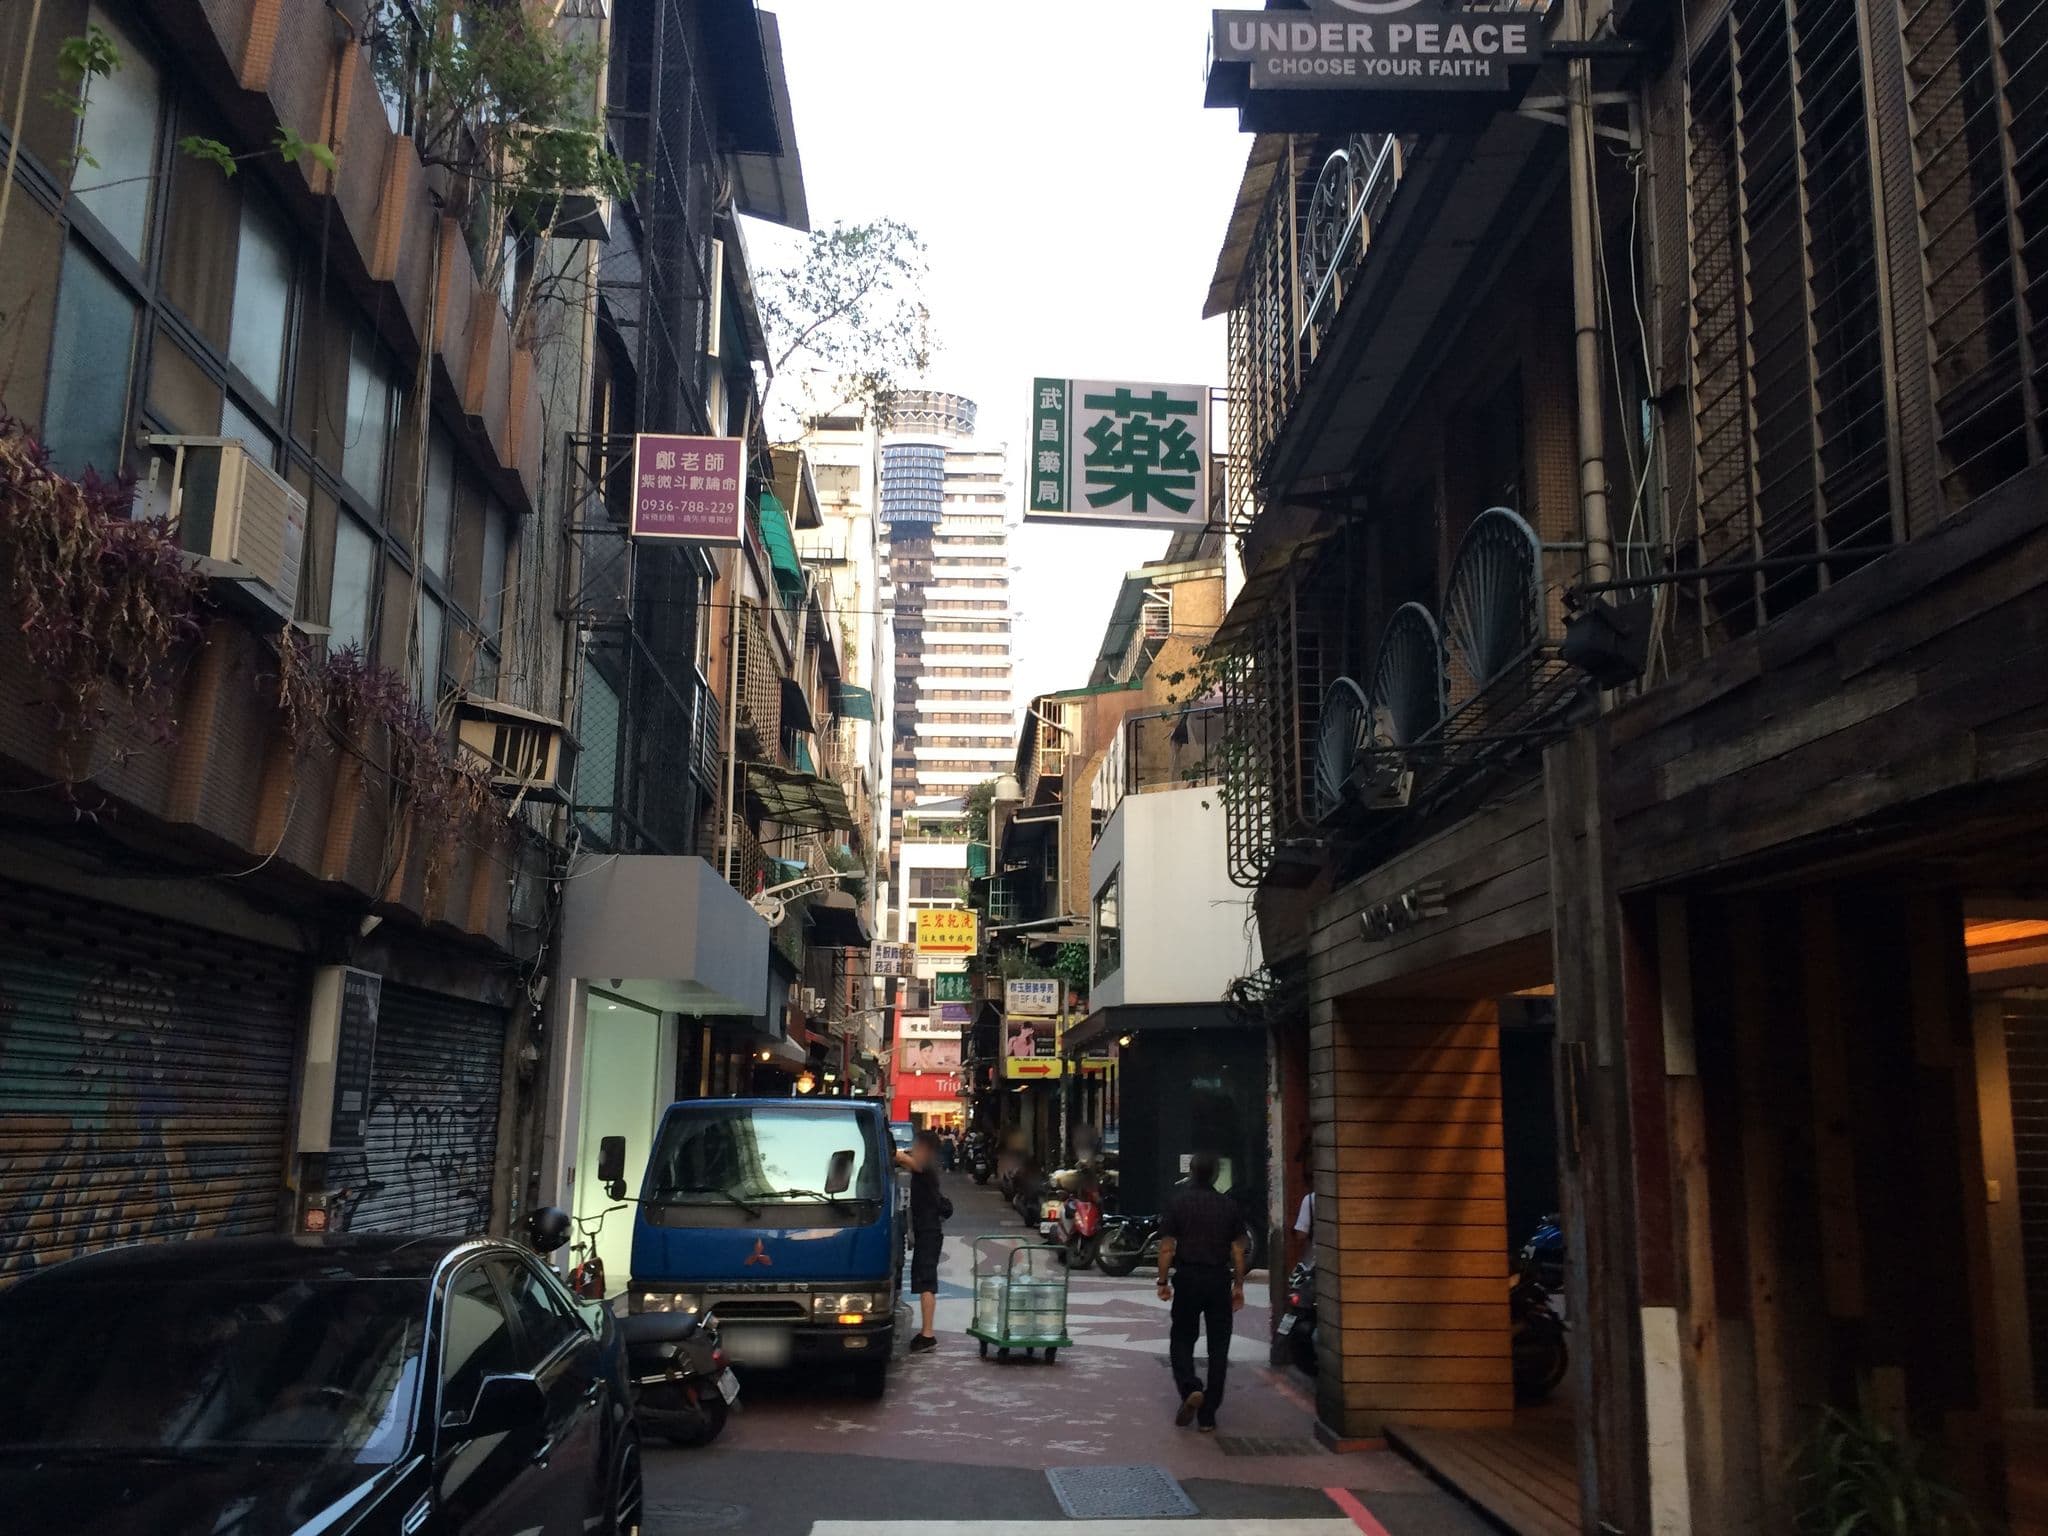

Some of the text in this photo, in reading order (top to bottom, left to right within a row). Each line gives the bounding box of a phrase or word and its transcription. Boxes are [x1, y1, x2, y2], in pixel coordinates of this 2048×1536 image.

[1228, 22, 1527, 54] UNDER PEACE
[1268, 58, 1490, 77] CHOOSE YOUR FAITH
[1037, 387, 1062, 504] 武昌藥局
[1083, 388, 1201, 514] 藥
[655, 450, 725, 472] 鄭老師
[641, 474, 736, 491] 紫微斗數論命
[641, 500, 735, 513] 0936-788-229
